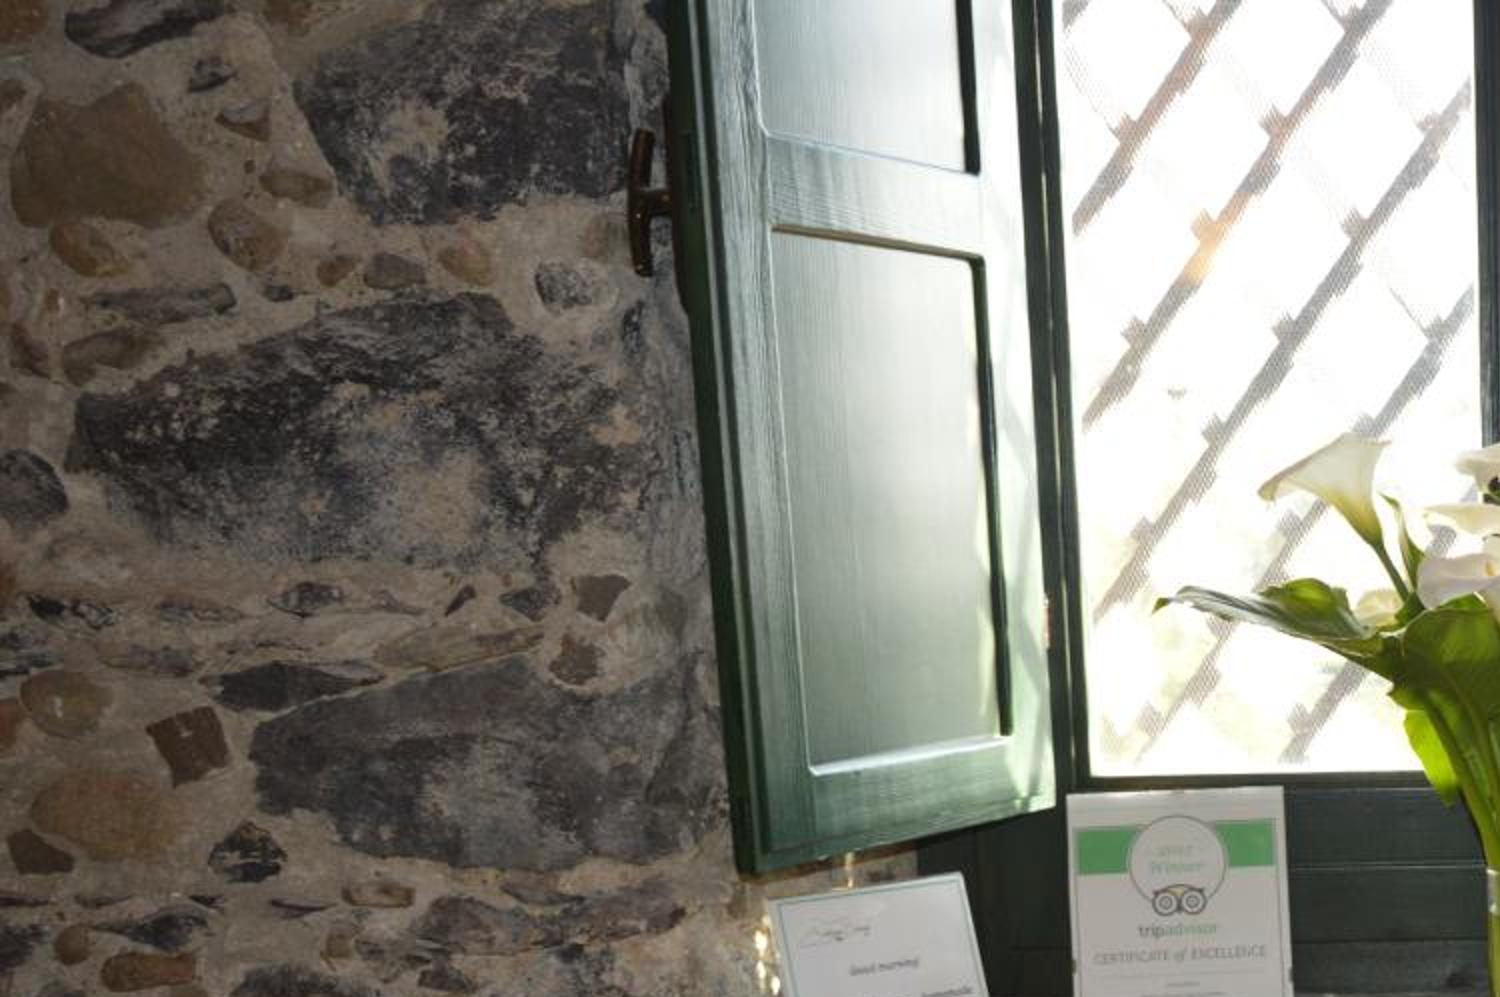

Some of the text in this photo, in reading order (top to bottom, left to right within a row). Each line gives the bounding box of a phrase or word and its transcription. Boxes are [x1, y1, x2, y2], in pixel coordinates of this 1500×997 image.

[1137, 921, 1219, 939] tripadvisor
[1091, 943, 1267, 966] CERTIFICATE of EXCELLENCE
[850, 963, 875, 977] Good
